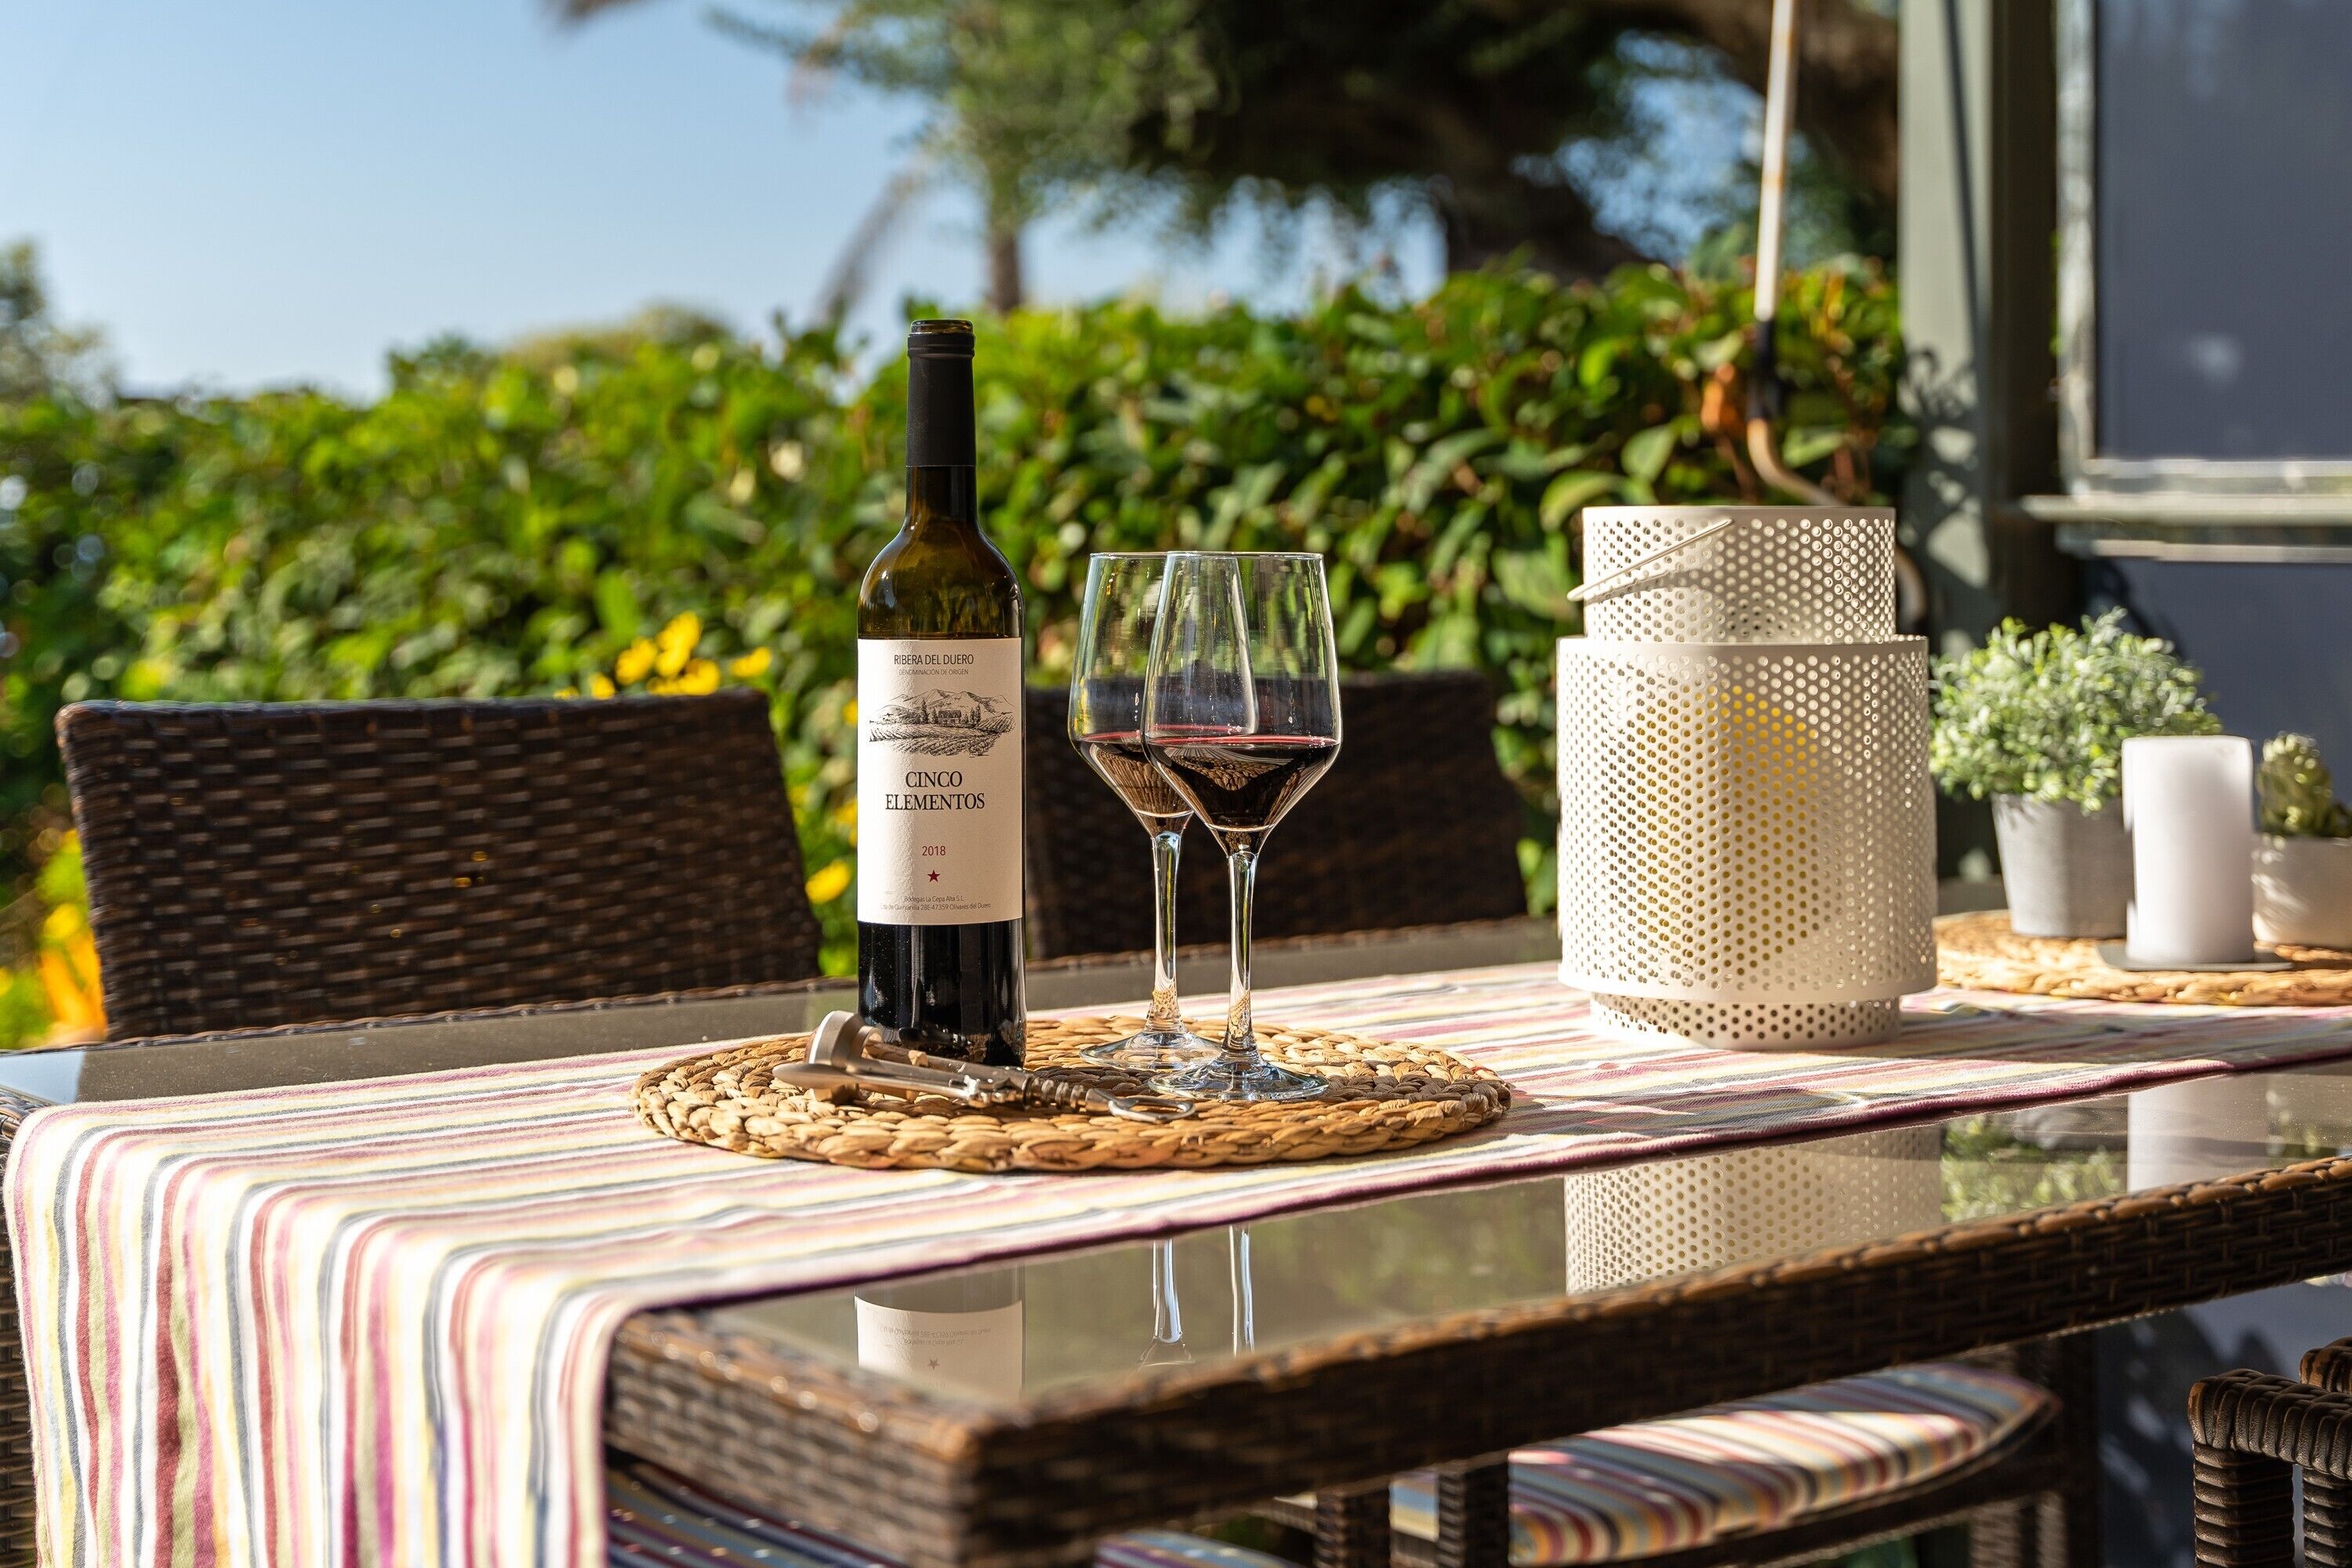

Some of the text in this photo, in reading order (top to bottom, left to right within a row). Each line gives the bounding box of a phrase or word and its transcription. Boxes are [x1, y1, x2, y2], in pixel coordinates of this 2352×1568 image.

[894, 654, 974, 665] RIBERA DEL DUERO
[906, 771, 963, 788] CINCO
[885, 793, 985, 811] ELEMENTOS
[921, 845, 946, 856] 2018
